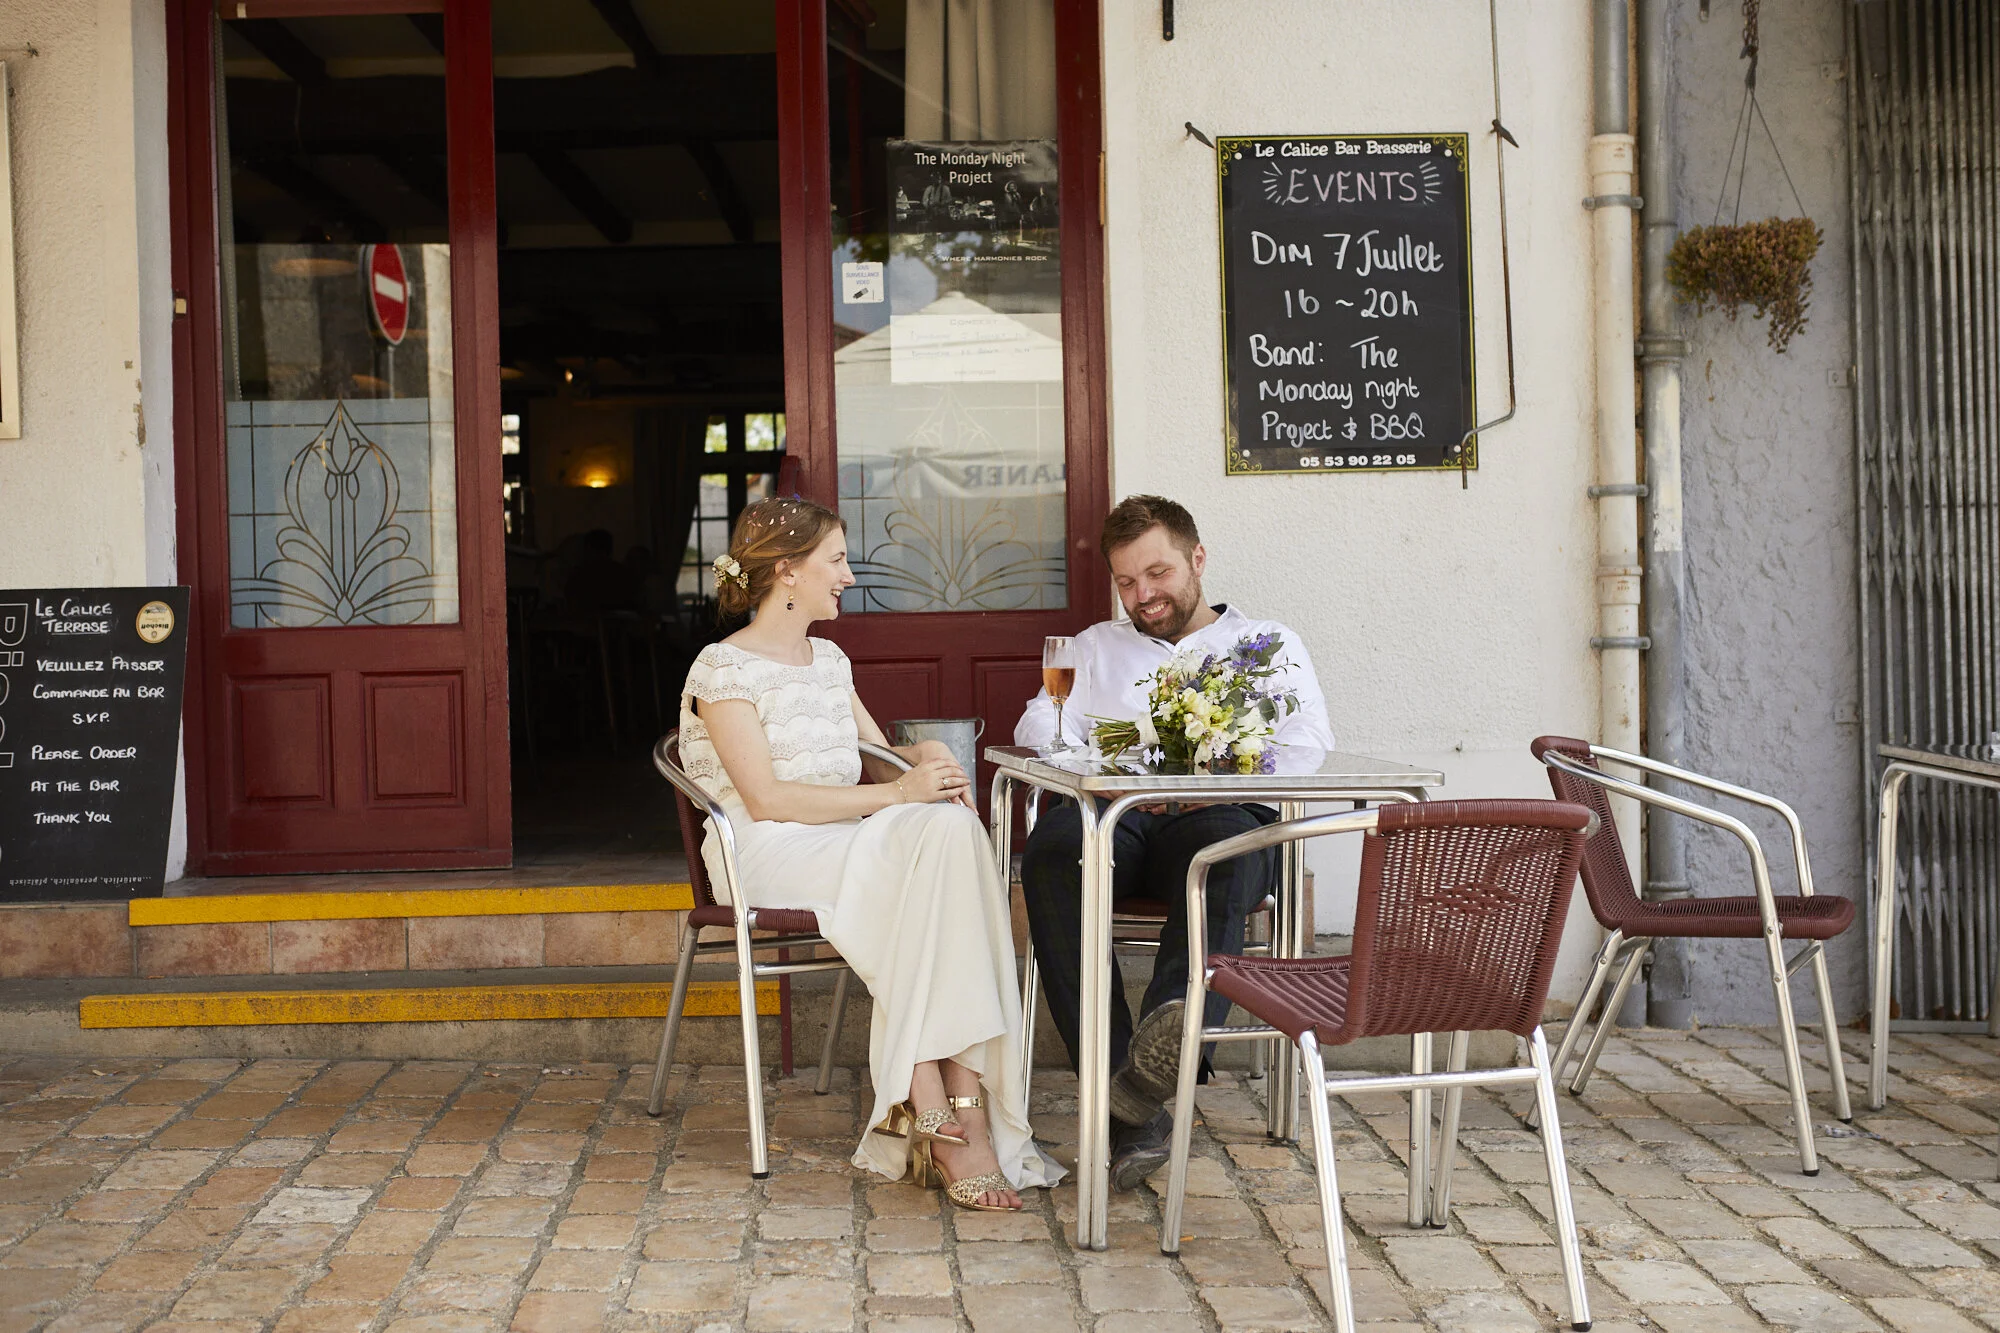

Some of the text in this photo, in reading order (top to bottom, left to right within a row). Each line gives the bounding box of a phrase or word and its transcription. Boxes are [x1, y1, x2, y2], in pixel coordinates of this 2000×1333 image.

[1255, 140, 1432, 158] Le Calice Bar Brasserie
[914, 151, 1026, 168] The Monday Night
[949, 171, 993, 187] Project
[1285, 167, 1418, 204] EVENTS
[1323, 233, 1351, 270] 7
[1249, 333, 1399, 369] Band: The
[1259, 376, 1420, 410] Monday night
[1261, 410, 1333, 448] Project
[1370, 412, 1426, 440] BBQ
[1300, 455, 1416, 468] 05 53 90 22 05
[36, 656, 164, 672] VEUILLEZ PASSER
[113, 687, 130, 699] AU
[137, 685, 165, 699] BAR
[31, 744, 137, 760] PLEASE ORDER
[30, 779, 120, 793] AT THE BAR
[33, 810, 112, 825] THANK YOU
